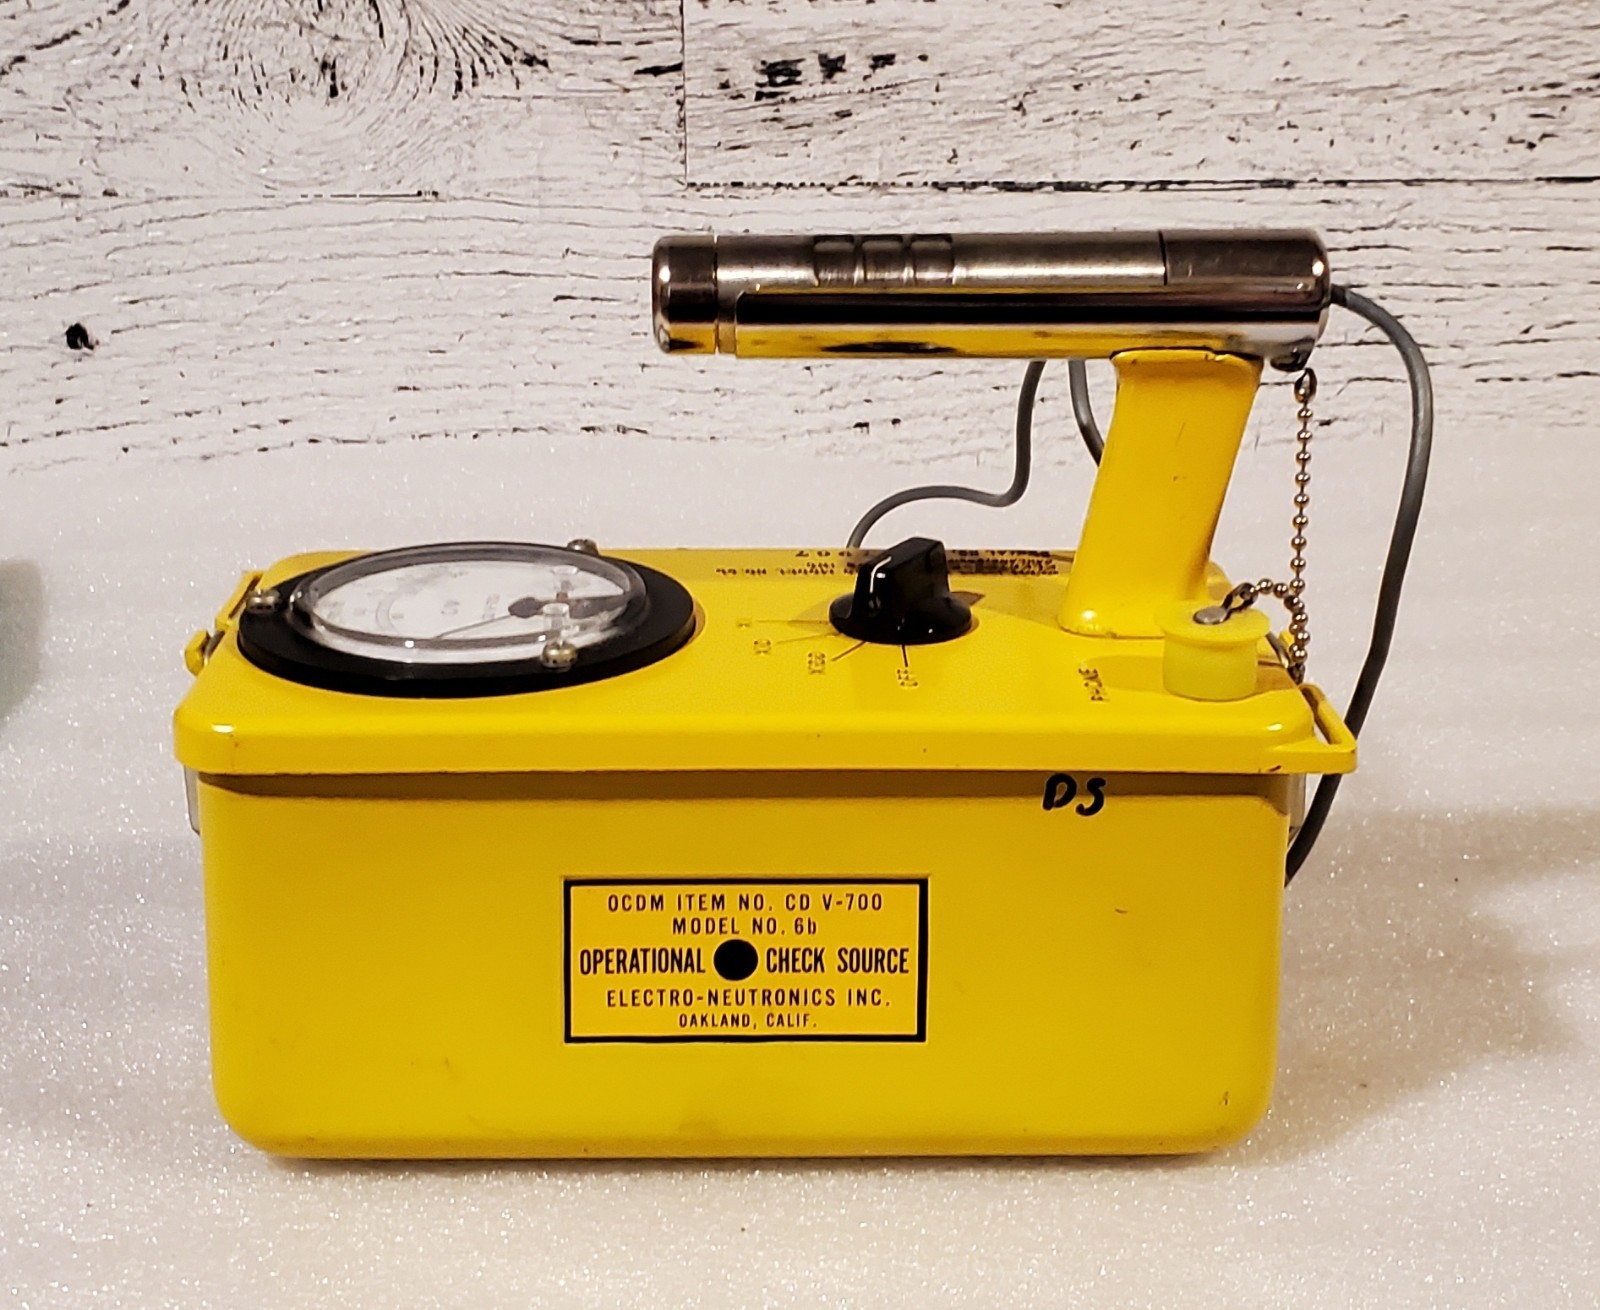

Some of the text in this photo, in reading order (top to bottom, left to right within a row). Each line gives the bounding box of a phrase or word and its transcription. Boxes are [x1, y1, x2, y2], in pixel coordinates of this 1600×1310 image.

[607, 893, 883, 912] OCDM ITEM NO. CD V-700
[672, 916, 818, 936] MODEL NO. 6b
[579, 947, 911, 976] OPERATIONAL CHECK SOURCE
[606, 988, 891, 1008] ELECTRO-NEUTRONICS INC.
[678, 1012, 818, 1030] OAKLAND, CALIF.
